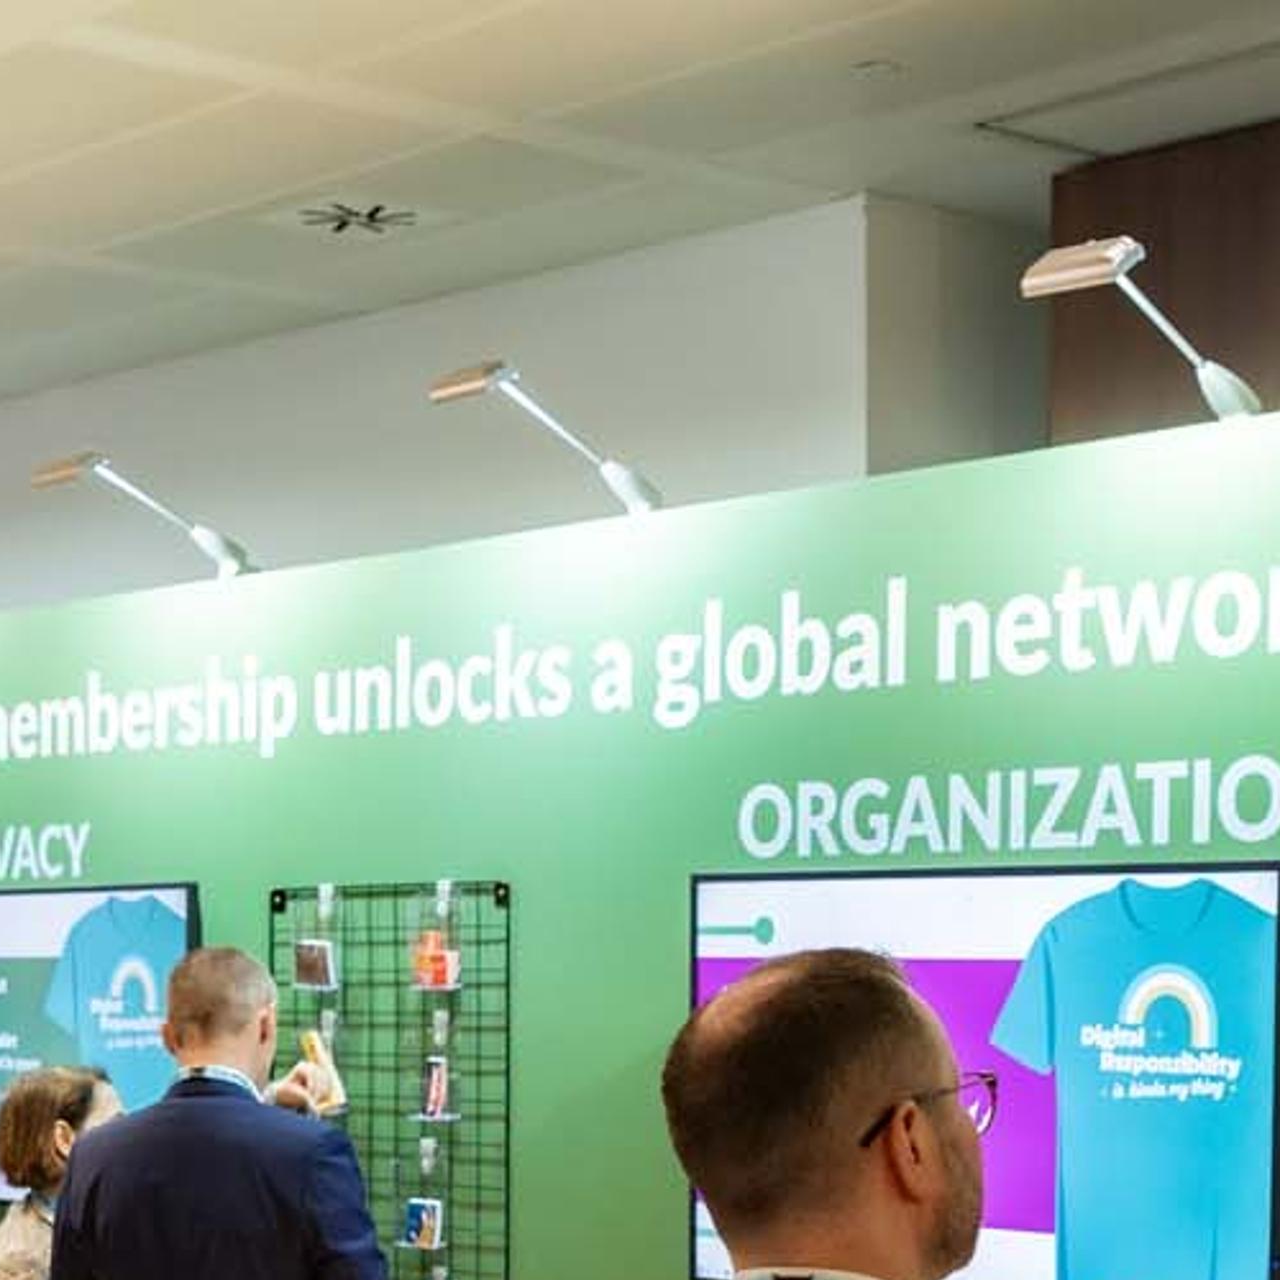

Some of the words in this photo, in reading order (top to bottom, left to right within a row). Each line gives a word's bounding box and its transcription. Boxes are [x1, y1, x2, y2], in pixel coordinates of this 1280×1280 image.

[314, 623, 574, 736] unlocks
[590, 638, 634, 712] a
[653, 576, 908, 729] global
[1079, 1023, 1146, 1050] Digital
[1100, 1050, 1242, 1080] Responsibility
